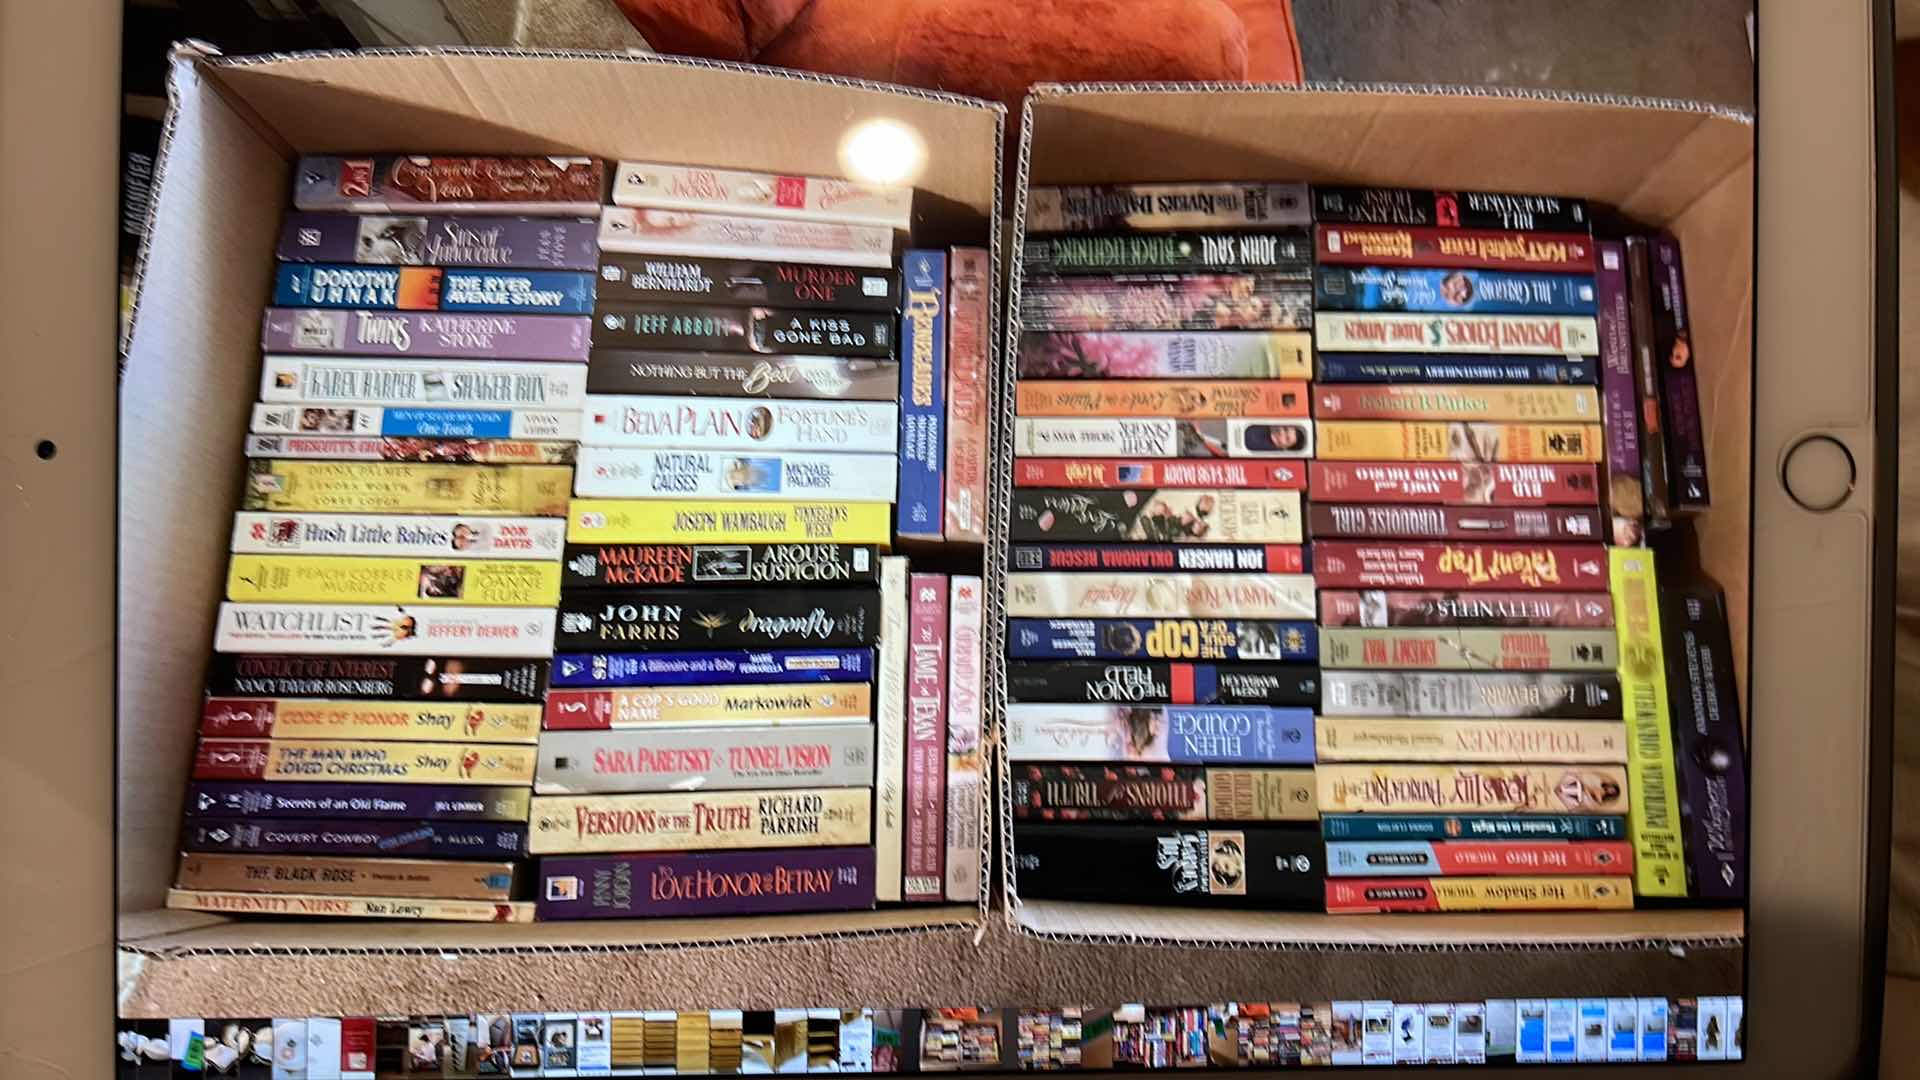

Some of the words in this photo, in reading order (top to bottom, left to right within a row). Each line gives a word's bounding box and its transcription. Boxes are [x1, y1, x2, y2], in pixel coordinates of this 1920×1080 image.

[1156, 192, 1217, 217] RIVER'S
[1468, 192, 1561, 214] SHOEMAKER
[1346, 204, 1427, 225] STALKING
[1502, 212, 1535, 230] BILL
[1052, 239, 1126, 266] LIGHTNING
[1129, 239, 1176, 266] BLACK
[1200, 235, 1236, 266] SAUL
[1239, 235, 1277, 266] JOHN
[1361, 243, 1414, 259] KAREN
[1438, 236, 1478, 258] FEVER
[1525, 239, 1568, 262] KAT
[315, 269, 400, 289] DOROTHY
[644, 261, 704, 278] WILLIAM
[775, 265, 858, 286] MURDER
[448, 275, 483, 292] THE
[484, 277, 533, 293] RYER
[631, 273, 715, 293] BERNHARDT
[794, 284, 836, 302] ONE
[446, 290, 510, 305] AVENUE
[511, 292, 565, 308] STORY
[1477, 282, 1530, 307] GREGORY
[1531, 281, 1557, 307] JILL
[418, 316, 518, 336] KATHERINE
[633, 314, 669, 334] JEFF
[671, 316, 732, 338] ABBOTT
[789, 317, 804, 331] A
[809, 318, 851, 333] KISS
[1343, 321, 1389, 344] AITKEN
[1444, 319, 1501, 351] ECHOES
[1501, 318, 1564, 352] DISTANT
[438, 332, 495, 350] STONE
[772, 329, 823, 346] GONE
[829, 331, 867, 348] BAD
[904, 288, 942, 408] RENEGADES
[310, 369, 362, 399] KAREN
[363, 371, 418, 400] HARPER
[452, 373, 513, 402] SHAKER
[629, 363, 692, 379] NOTHING
[693, 365, 723, 380] BUT
[740, 359, 796, 396] Best
[1359, 394, 1415, 410] Robert
[1434, 394, 1489, 412] Parker
[621, 406, 675, 436] BELVA
[674, 406, 744, 438] PLAIN
[776, 407, 871, 427] FORTUNE'S
[794, 424, 851, 445] HAND
[1118, 422, 1172, 441] SINGER
[1119, 439, 1166, 456] NIGHT
[652, 453, 714, 474] NATURAL
[785, 462, 835, 478] MICHAEL
[1497, 464, 1557, 483] MEDICINE
[651, 472, 700, 493] CAUSES
[786, 473, 833, 489] PALMER
[1225, 464, 1247, 485] THE
[1354, 467, 1412, 482] THURLO
[1512, 481, 1544, 499] BAD
[672, 512, 718, 533] JOSEPH
[720, 512, 788, 533] WAMBAUGH
[792, 505, 849, 522] FINNEGAN'S
[1330, 506, 1367, 534] GIRL
[1368, 509, 1449, 537] TURQUOISE
[304, 523, 346, 543] Hush
[349, 524, 393, 544] Little
[396, 525, 449, 546] Babies
[499, 526, 530, 538] DON
[803, 519, 834, 539] WEEK
[493, 537, 534, 550] DAVIS
[597, 545, 694, 567] MAUREEN
[760, 543, 842, 565] AROUSE
[1048, 549, 1098, 569] RESCUE
[1100, 550, 1174, 569] OKLAHOMA
[1178, 549, 1234, 570] HANSEN
[1236, 549, 1264, 569] JON
[296, 567, 344, 581] PEACH
[347, 568, 414, 582] COBBLER
[603, 564, 687, 585] McKADE
[750, 561, 852, 583] SUSPICION
[1436, 545, 1491, 584] Trap
[1487, 548, 1562, 585] Parent
[320, 580, 388, 594] MURDER
[474, 576, 543, 591] JOANNE
[481, 590, 533, 603] FLUKE
[598, 603, 683, 624] JOHN
[1436, 599, 1496, 619] NEELS
[1497, 599, 1552, 619] BETTY
[231, 610, 370, 633] WATCHLIST
[598, 622, 682, 641] FARRIS
[738, 606, 836, 641] dragonfly
[427, 624, 475, 639] JEFFERY
[476, 625, 520, 640] DEAVER
[1144, 620, 1200, 658] COP
[1200, 632, 1238, 646] SOUL
[913, 637, 942, 684] TAME
[1200, 645, 1229, 658] THE
[1360, 639, 1390, 666] WAY
[235, 660, 308, 678] CONFLICT
[310, 661, 328, 678] OF
[329, 661, 397, 679] INTEREST
[1103, 665, 1153, 684] FIELD
[1086, 680, 1146, 702] ONION
[1144, 682, 1168, 698] THE
[1230, 685, 1270, 698] JOSEPH
[617, 695, 631, 709] A
[633, 695, 675, 708] COP'S
[678, 694, 721, 707] GOOD
[723, 694, 814, 713] Markowiak
[281, 711, 325, 727] CODE
[328, 712, 349, 727] OF
[352, 712, 410, 728] HONOR
[415, 711, 457, 731] Shay
[617, 707, 662, 722] NAME
[912, 695, 942, 742] TEXAN
[1171, 712, 1252, 736] GOUDGE
[278, 748, 307, 761] THE
[309, 749, 347, 761] MAN
[350, 750, 388, 762] WHO
[1183, 735, 1242, 758] EILEEN
[415, 754, 452, 773] Shay
[592, 747, 638, 775] SARA
[637, 746, 716, 774] PARETSKY
[727, 744, 784, 774] TUNNEL
[783, 742, 834, 769] VISION
[275, 761, 323, 775] LOVED
[325, 762, 409, 776] CHRISTMAS
[1044, 781, 1101, 809] TRUTH
[1126, 781, 1191, 807] THORNS
[1362, 774, 1392, 807] RICE
[1391, 776, 1444, 809] PATRICIA
[275, 796, 319, 812] Secrets
[319, 797, 333, 812] of
[333, 799, 350, 811] an
[350, 798, 372, 812] Old
[373, 798, 408, 812] Flame
[757, 795, 824, 817] RICHARD
[575, 806, 659, 840] VERSIONS
[658, 814, 673, 831] OF
[673, 814, 691, 831] THE
[692, 801, 754, 836] TRUTH
[758, 814, 821, 836] PARRISH
[1471, 820, 1496, 834] Night
[1522, 821, 1557, 834] Thunder
[264, 831, 320, 846] COVERT
[321, 832, 378, 846] COWBOY
[1454, 852, 1498, 864] THURLO
[1506, 852, 1539, 868] Hero
[1542, 852, 1569, 868] Her
[245, 865, 272, 882] THE
[273, 866, 317, 883] BLACK
[320, 867, 356, 884] ROSE
[650, 868, 698, 902] LOVE
[696, 867, 765, 900] HONOR
[774, 864, 835, 897] BETRAY
[194, 893, 292, 912] MATERNITY
[296, 897, 354, 914] NURSE
[1485, 886, 1538, 901] Shadow
[1541, 886, 1566, 901] Her
